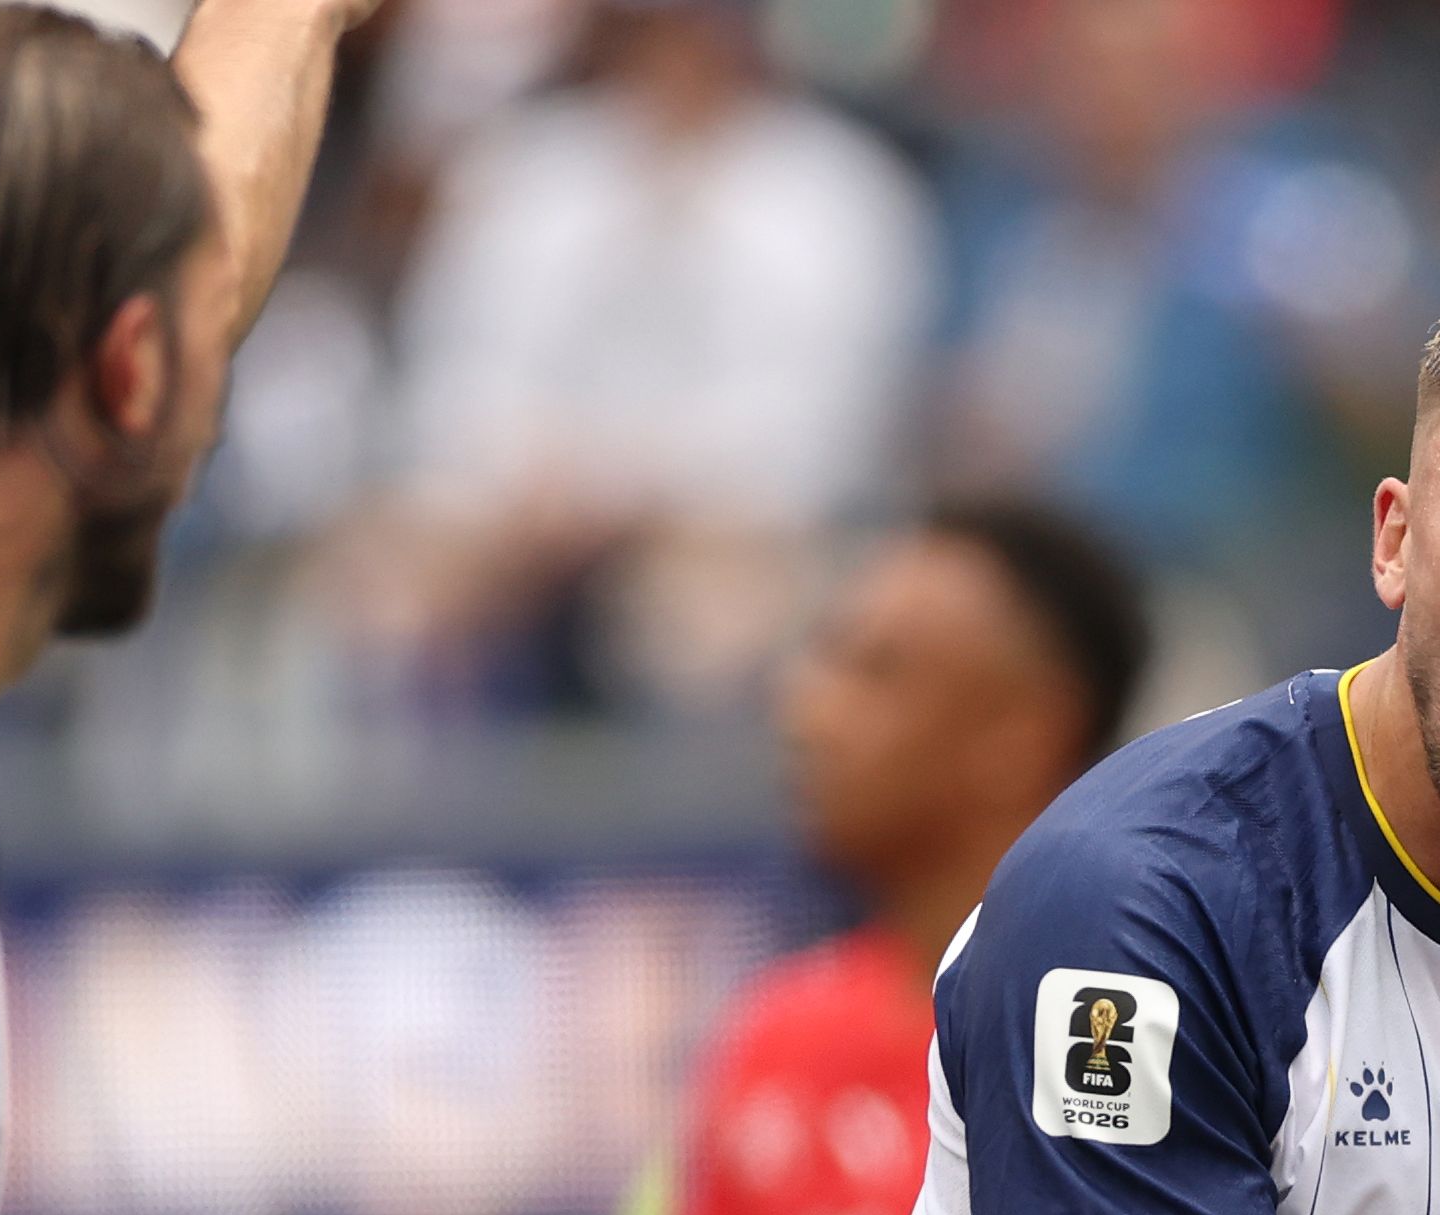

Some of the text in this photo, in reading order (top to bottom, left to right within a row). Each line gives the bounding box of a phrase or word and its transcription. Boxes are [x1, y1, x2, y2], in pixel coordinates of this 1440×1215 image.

[1082, 1073, 1114, 1088] FIFA
[1062, 1096, 1130, 1112] WORLD CUP
[1062, 1109, 1129, 1129] 2026
[1334, 1130, 1411, 1147] KELME
